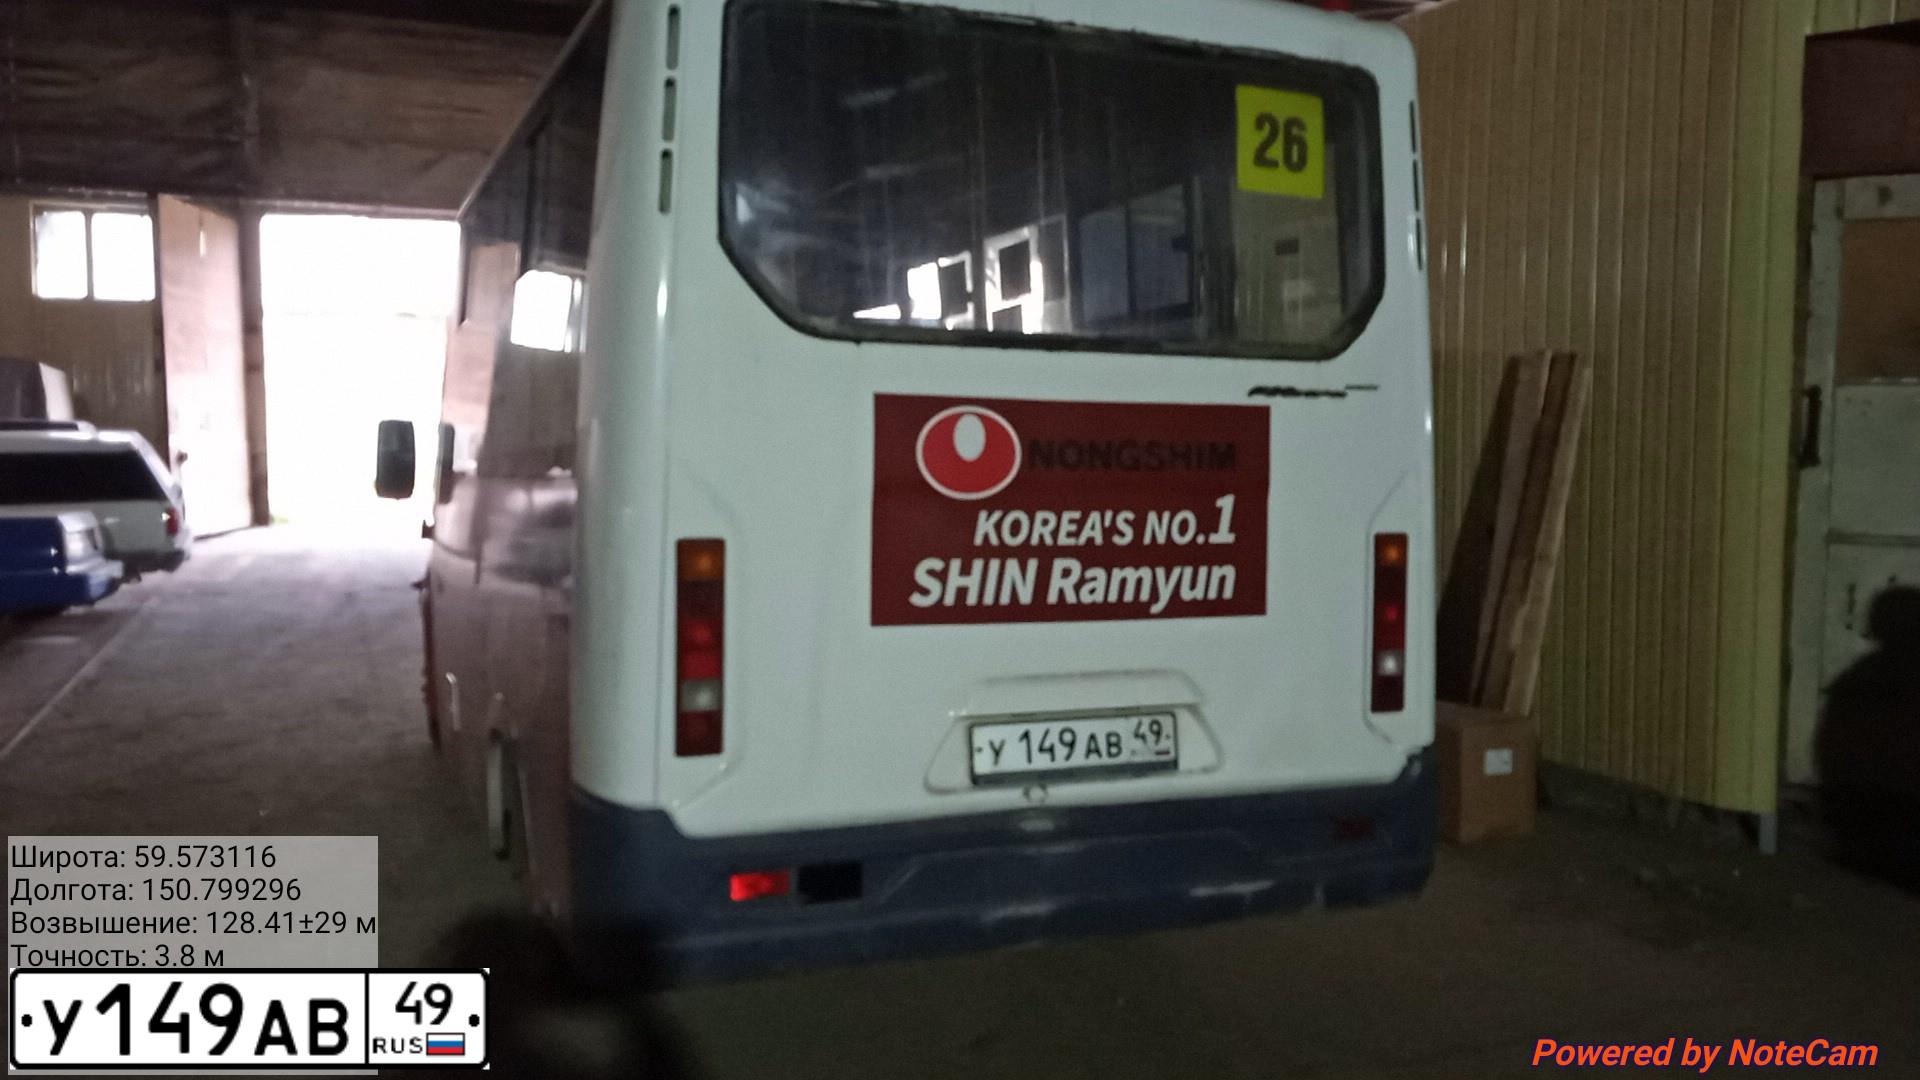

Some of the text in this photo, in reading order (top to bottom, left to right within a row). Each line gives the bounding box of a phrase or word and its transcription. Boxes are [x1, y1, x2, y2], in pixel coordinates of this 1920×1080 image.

[1253, 112, 1308, 173] 26
[1027, 439, 1237, 471] NONGSHIM
[973, 494, 1236, 547] KOREA'S NO.1
[909, 557, 1237, 615] SHIN Ramyun
[1133, 719, 1164, 746] 49
